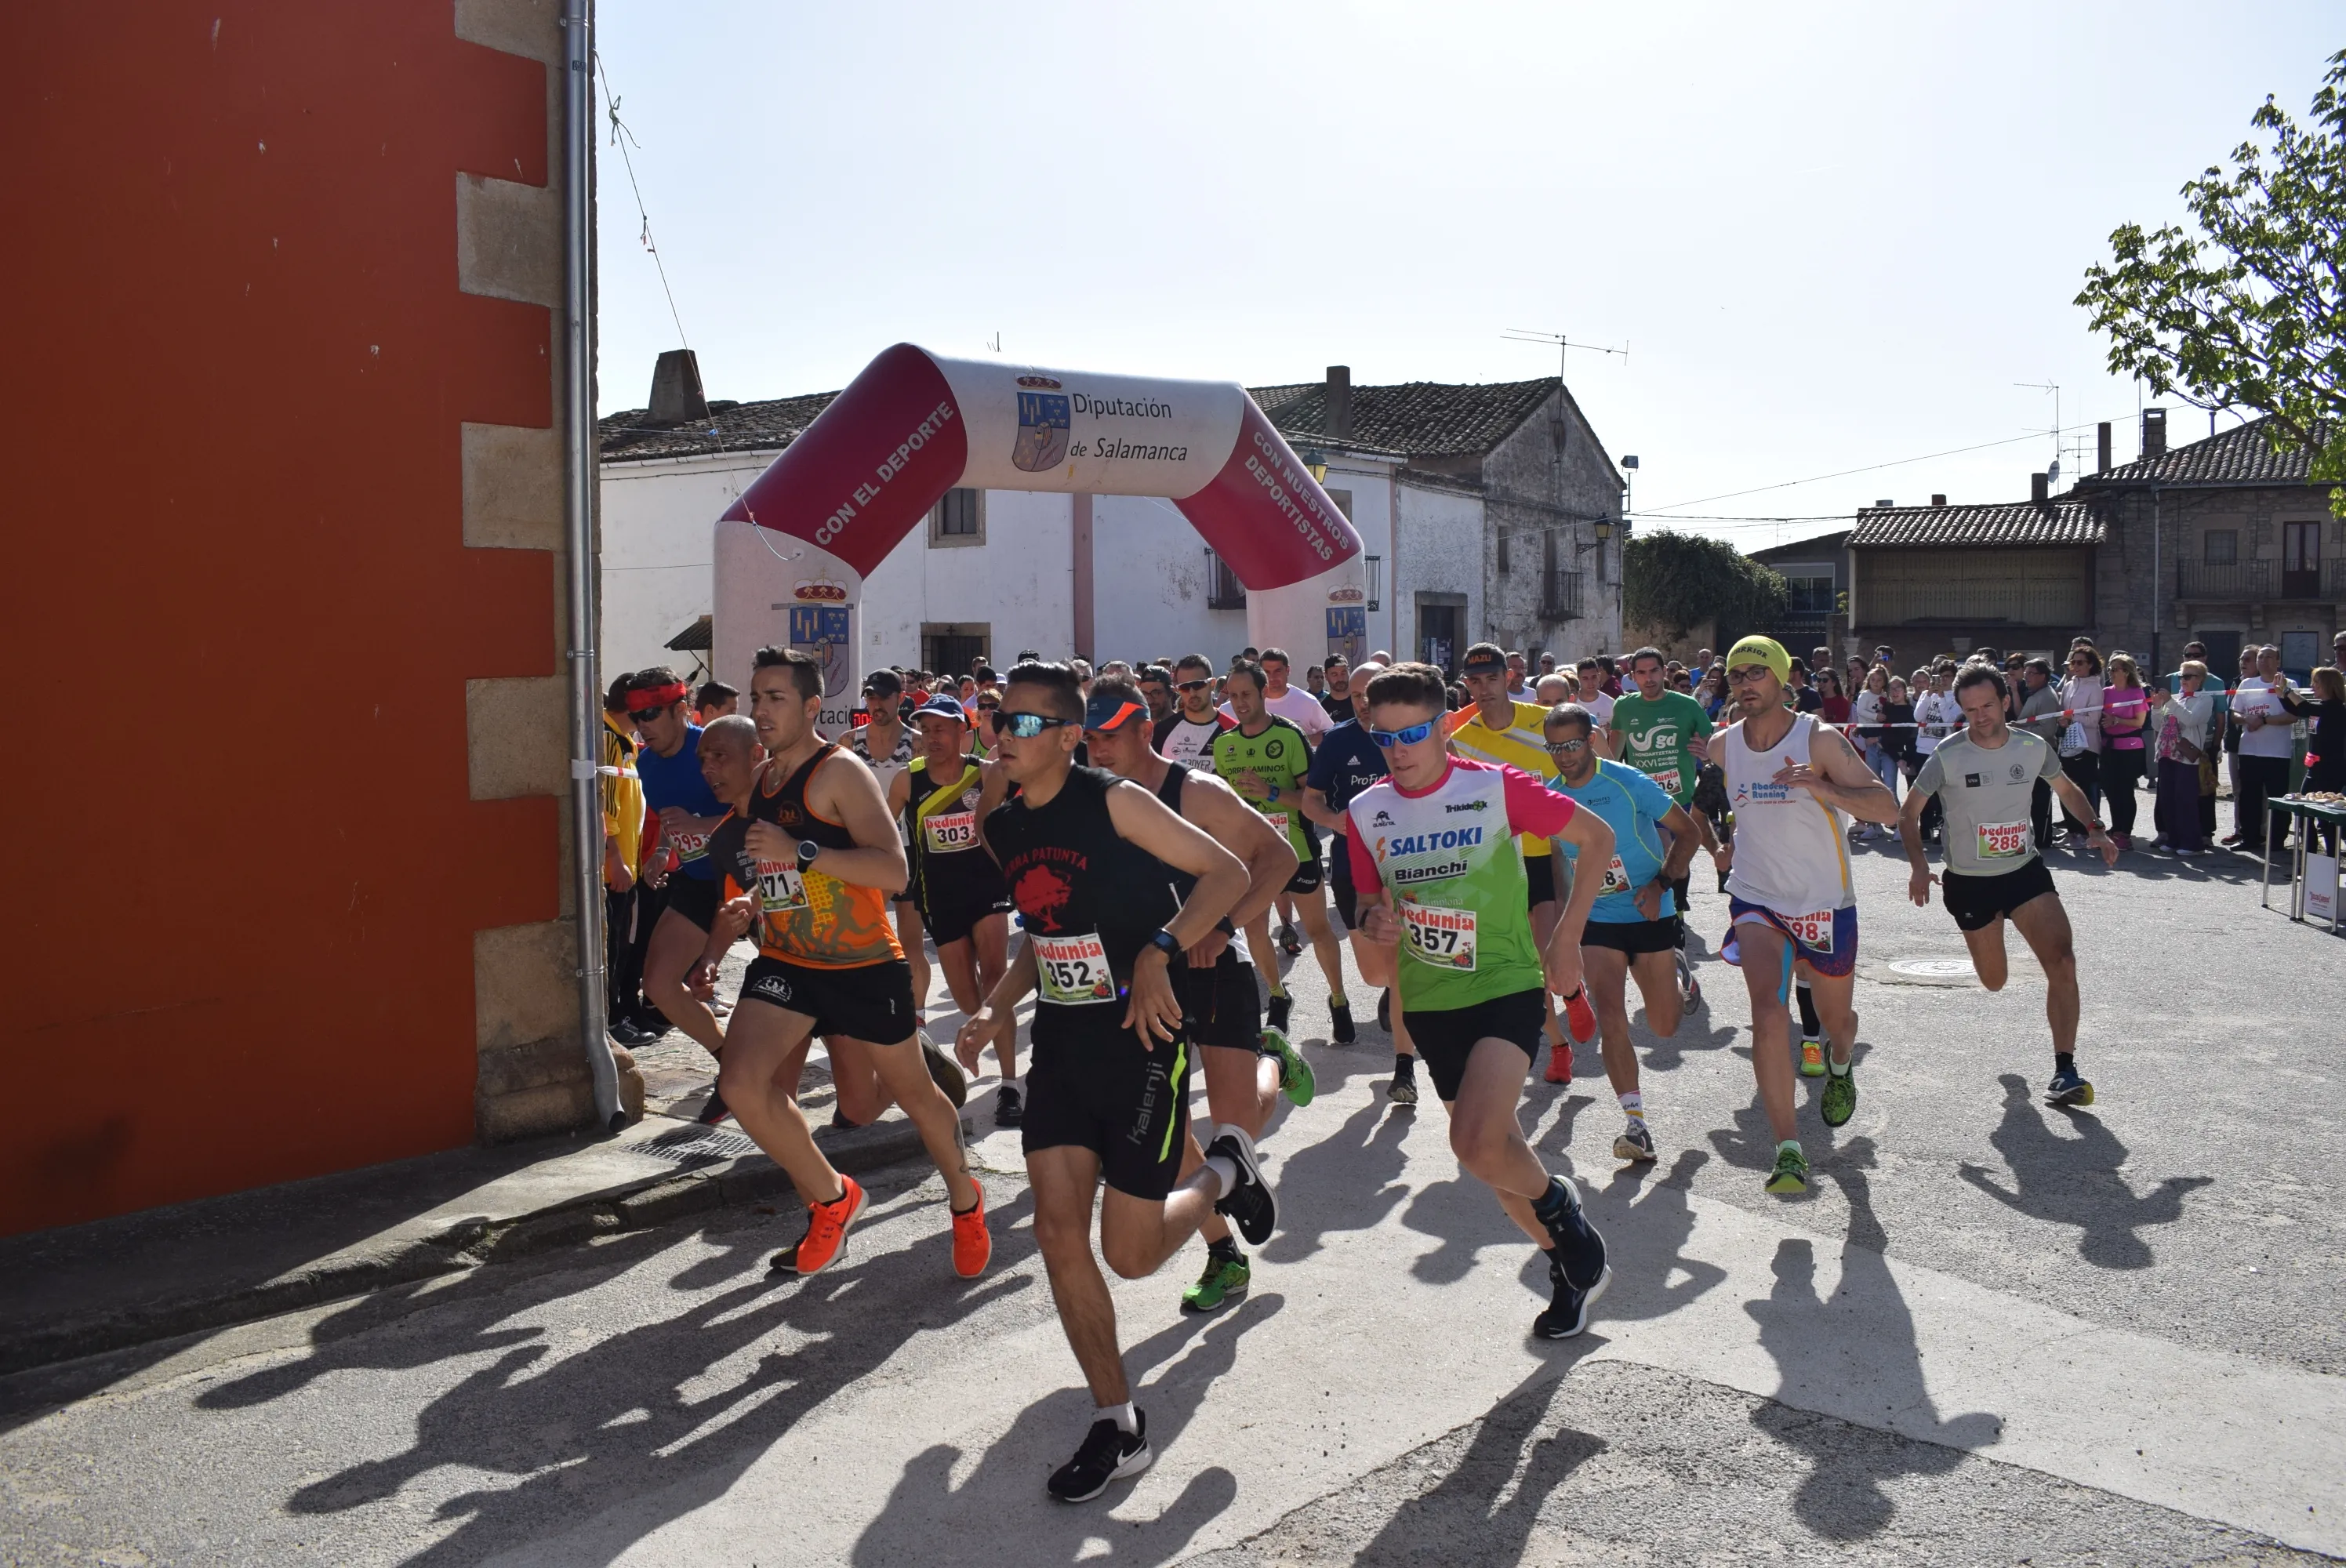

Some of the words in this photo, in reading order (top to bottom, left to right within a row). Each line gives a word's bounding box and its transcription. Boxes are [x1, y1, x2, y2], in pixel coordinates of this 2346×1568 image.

[1073, 394, 1172, 419] Diputación
[1070, 441, 1088, 456] de
[1094, 437, 1188, 461] Salamanca
[815, 503, 856, 545] CON
[852, 482, 881, 506] EL
[877, 401, 953, 483] DEPORTE
[1254, 432, 1283, 469] CON
[1283, 467, 1349, 550] NUESTROS
[1244, 455, 1333, 561] DEPORTISTAS
[1635, 759, 1658, 768] XXVI
[1752, 782, 1794, 791] Abadeng
[1752, 790, 1786, 800] Running
[937, 826, 970, 844] 303
[1979, 822, 2026, 837] bedunia
[674, 834, 703, 853] 295
[1390, 827, 1482, 857] SALTOKI
[1988, 835, 2019, 852] 288
[1033, 847, 1088, 870] PATUNTA
[1395, 860, 1467, 880] Bianchi
[1409, 924, 1458, 953] 357
[1032, 940, 1103, 961] bedunia
[1046, 960, 1095, 989] 352
